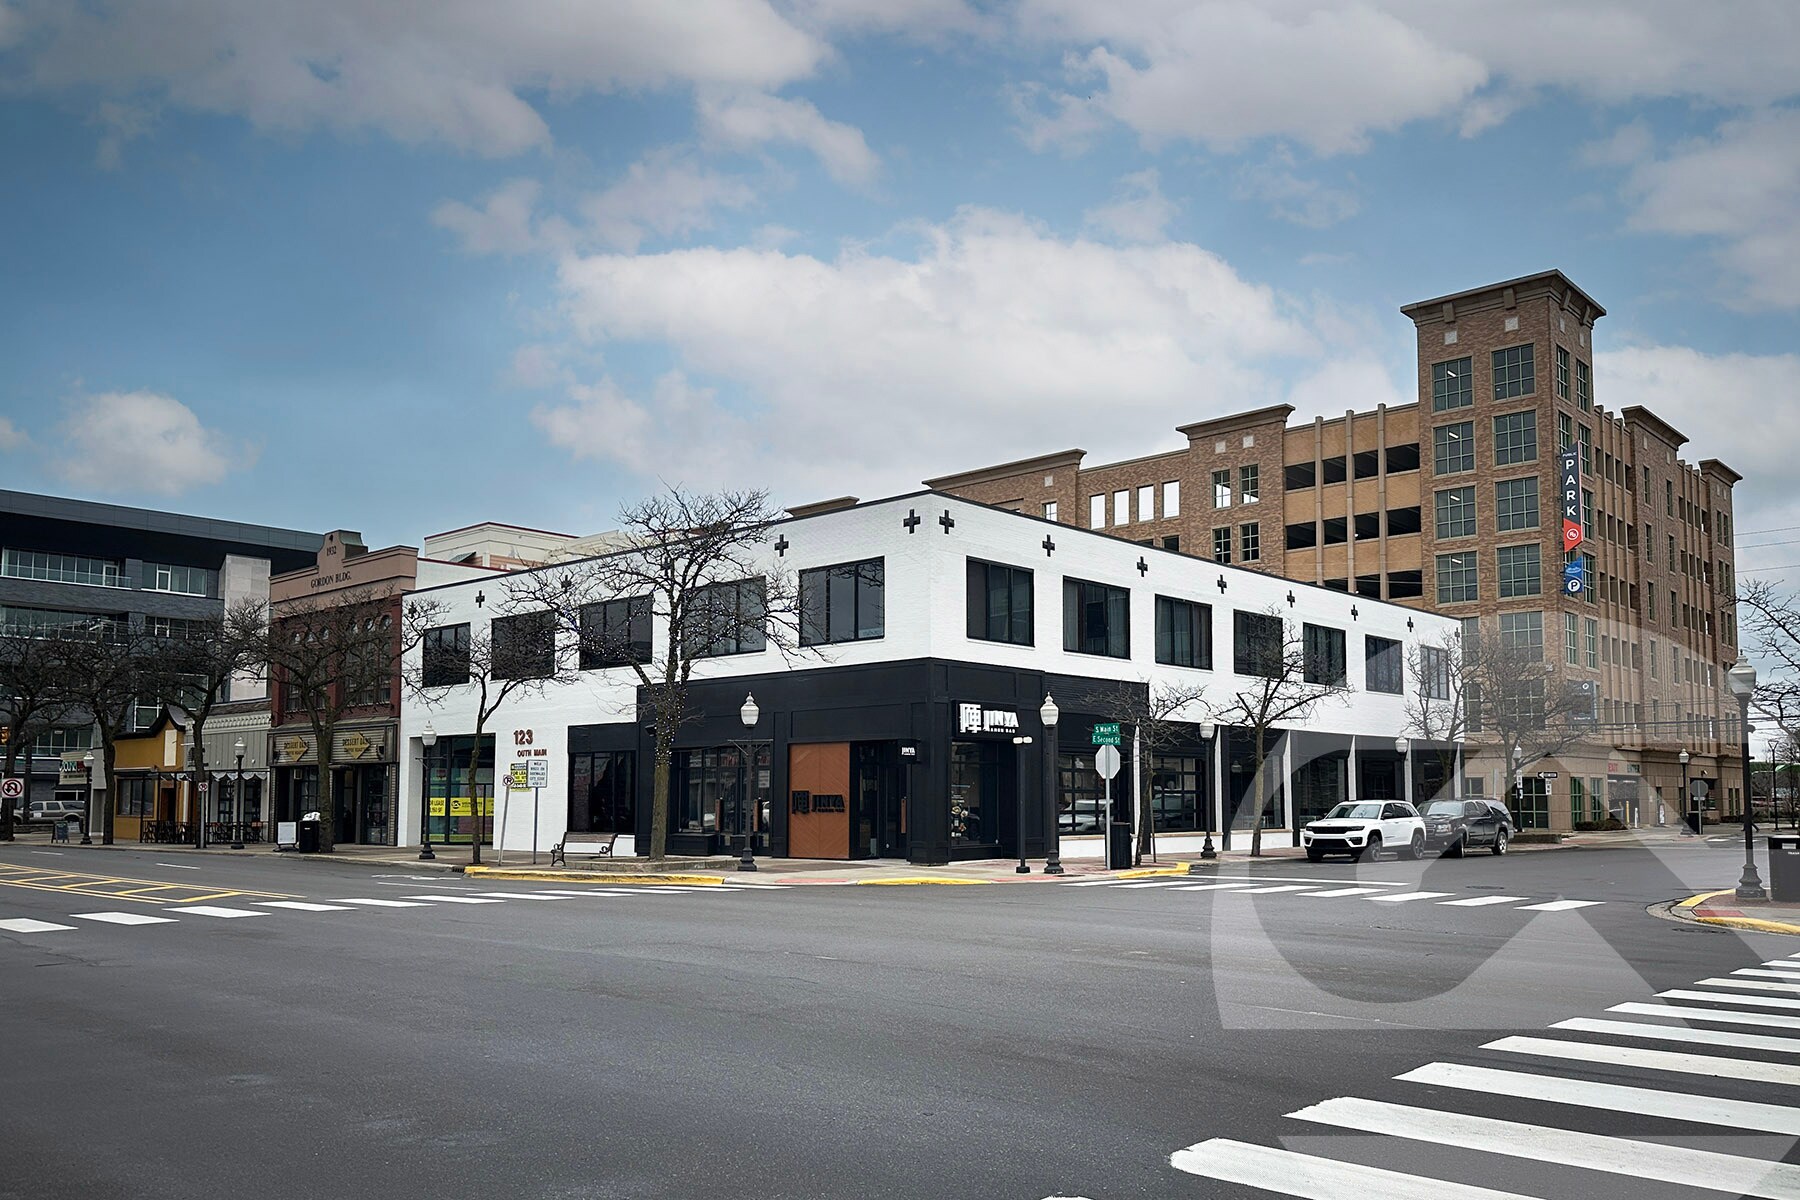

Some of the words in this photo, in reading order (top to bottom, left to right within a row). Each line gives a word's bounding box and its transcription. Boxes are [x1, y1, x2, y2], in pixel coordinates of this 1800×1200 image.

[1565, 459, 1577, 517] PARK
[326, 546, 337, 556] 1932
[311, 575, 334, 588] GORDON
[983, 710, 1019, 731] JINYA
[513, 729, 533, 745] 123
[1092, 735, 1096, 743] E
[1097, 735, 1114, 743] Second
[812, 794, 845, 812] JINYA
